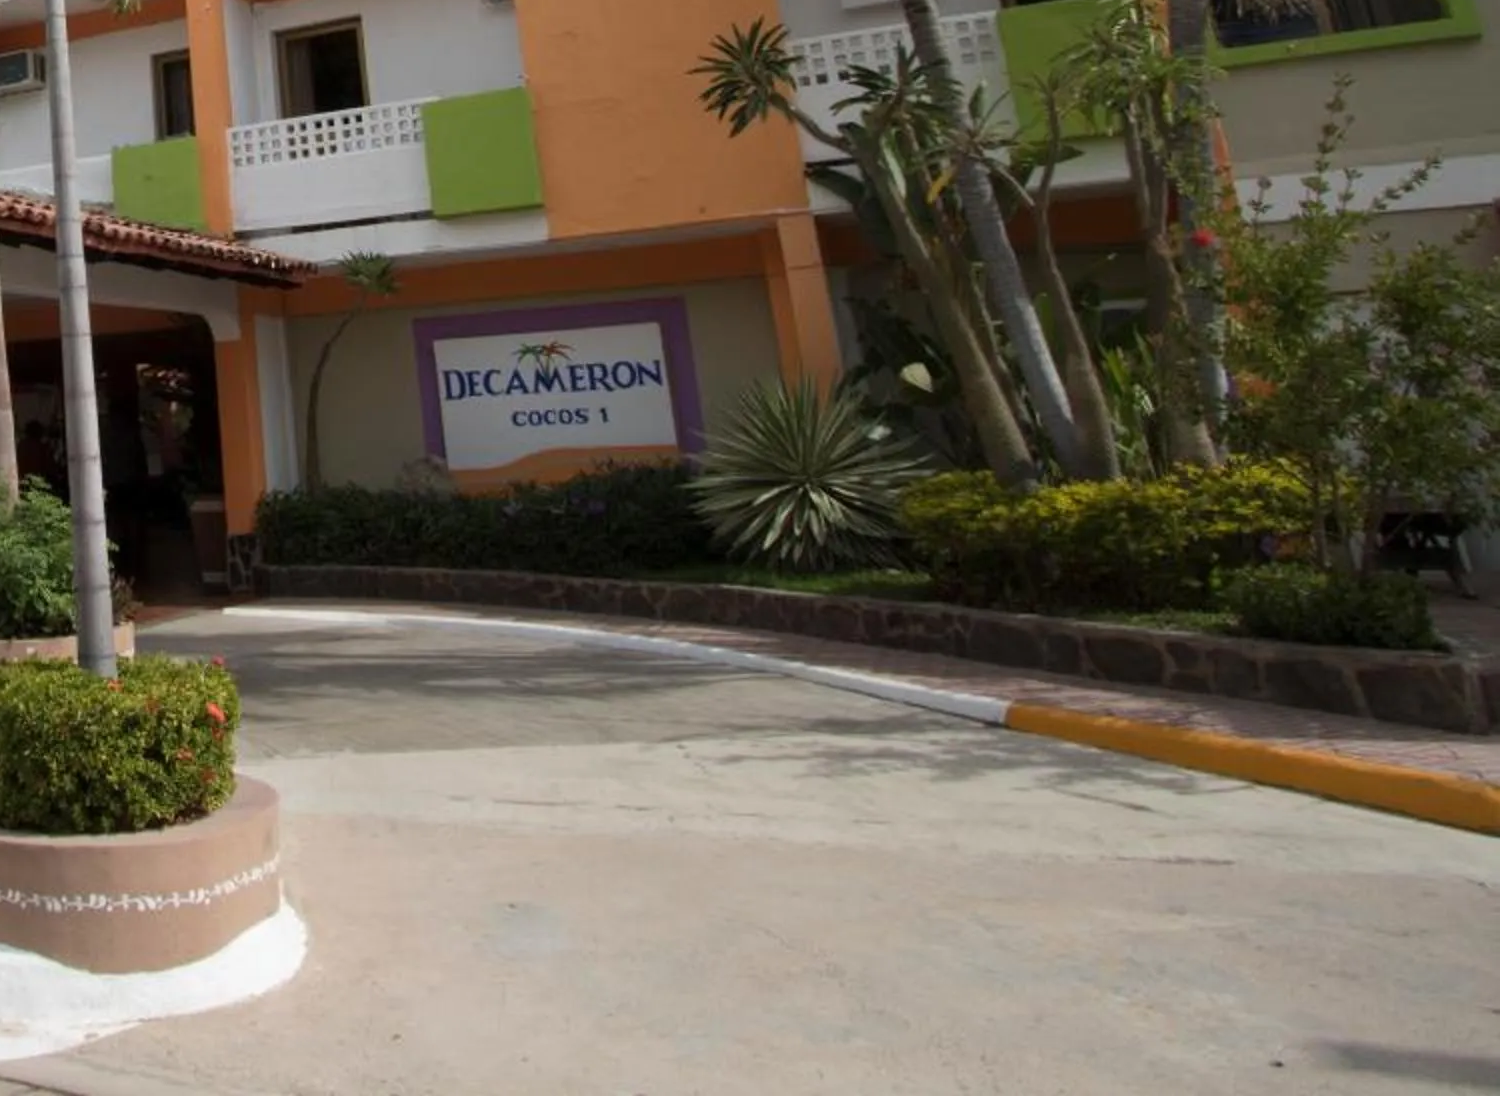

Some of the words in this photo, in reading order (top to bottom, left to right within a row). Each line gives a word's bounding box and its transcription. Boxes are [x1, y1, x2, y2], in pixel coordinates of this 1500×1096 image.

[442, 359, 663, 401] DECAMERON
[511, 408, 589, 427] COCOS
[600, 407, 609, 423] 1
